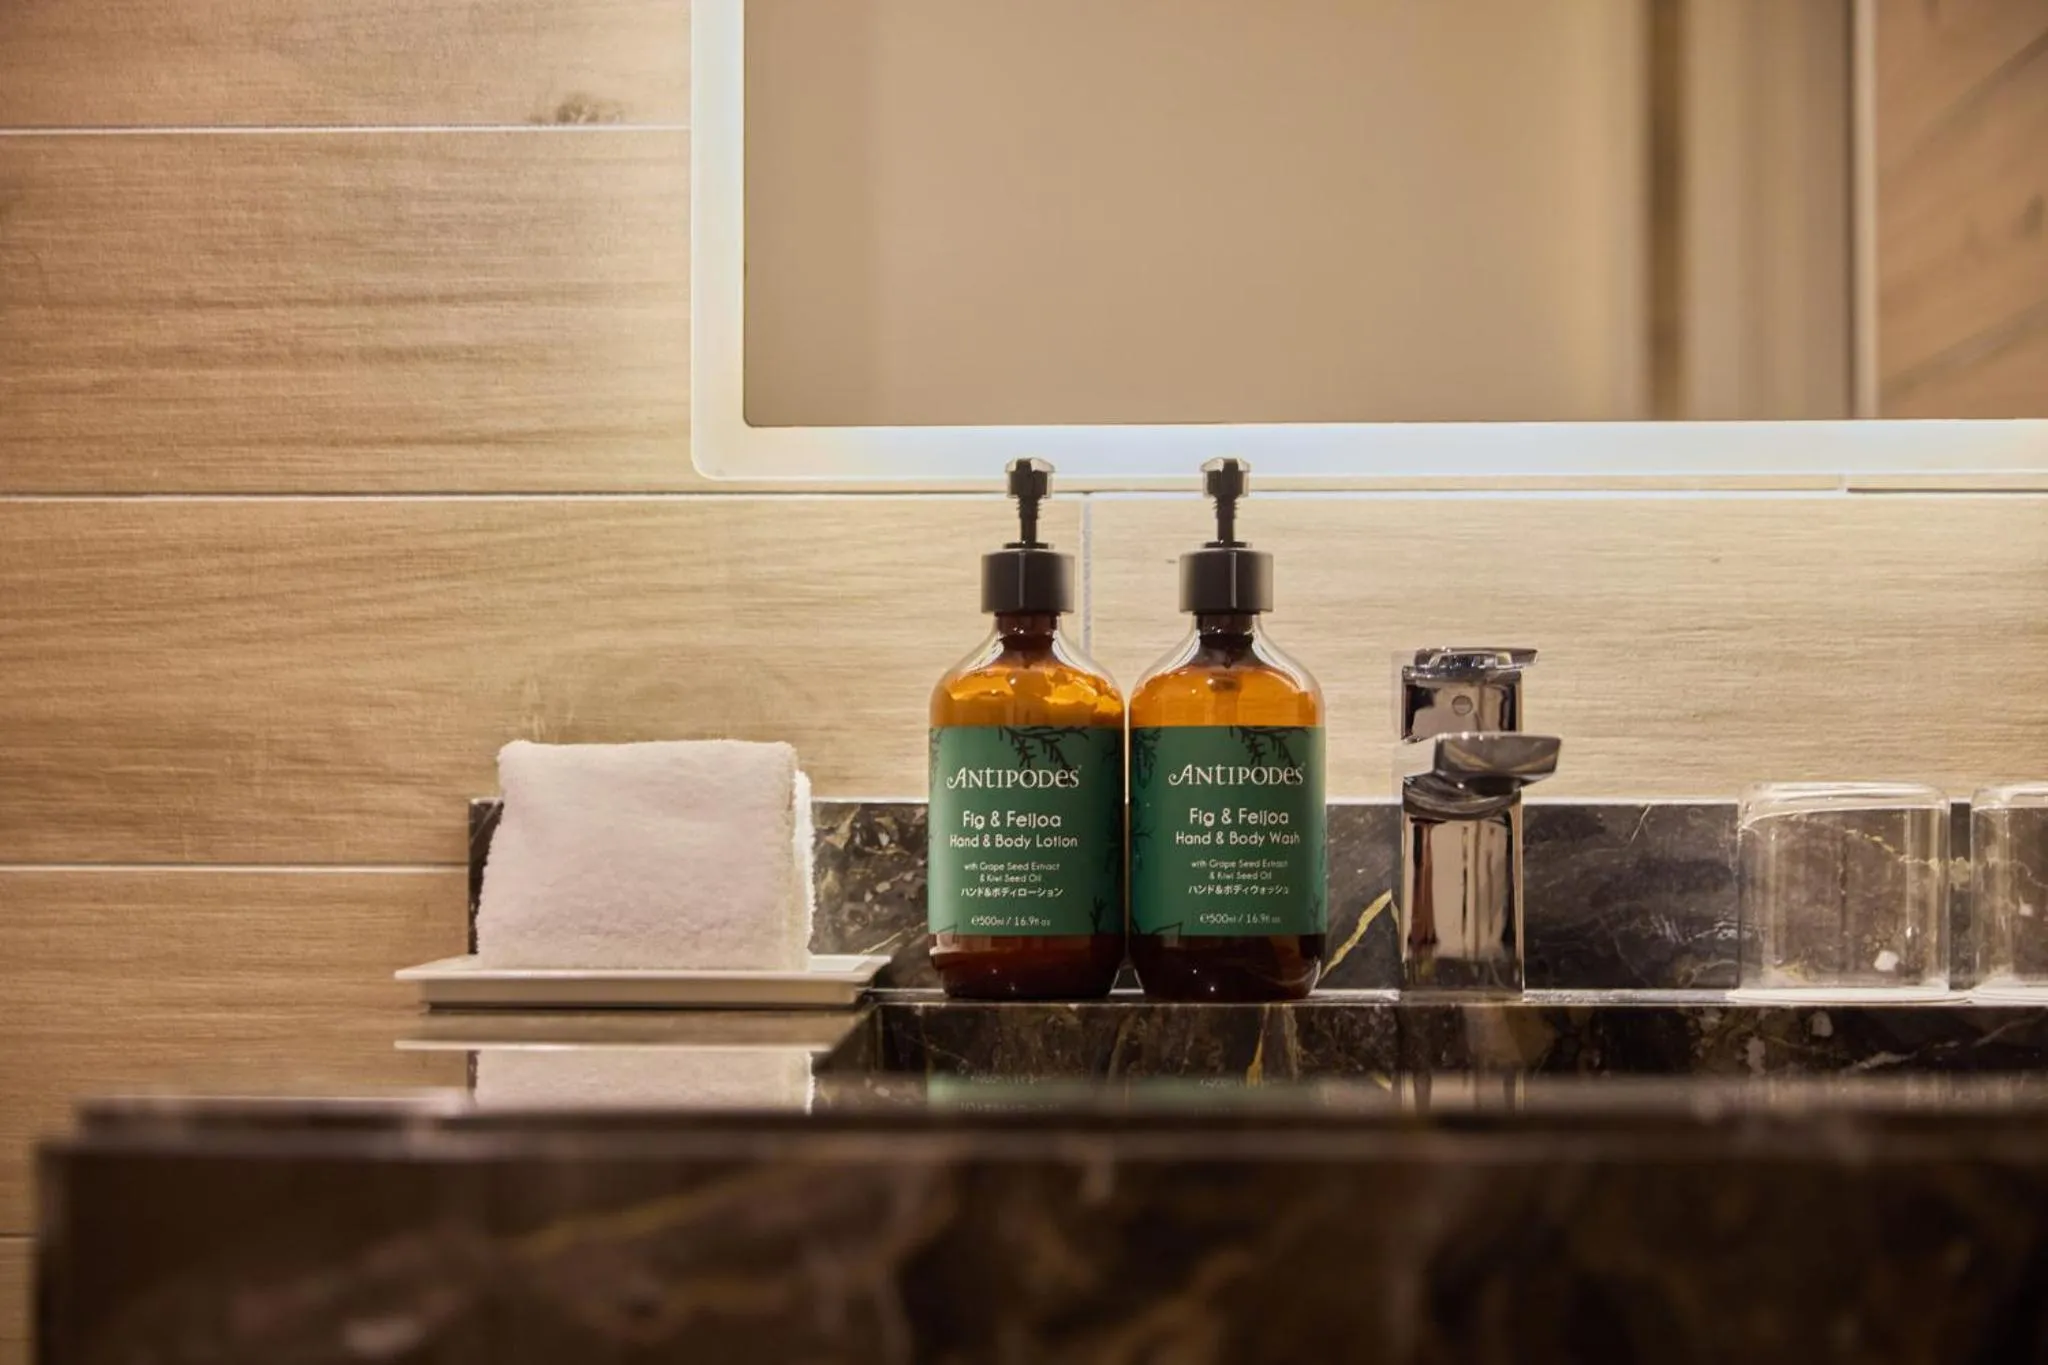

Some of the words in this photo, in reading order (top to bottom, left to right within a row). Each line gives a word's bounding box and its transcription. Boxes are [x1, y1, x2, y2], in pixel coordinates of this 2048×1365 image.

[963, 810, 985, 830] Fig
[990, 810, 1000, 827] &
[1007, 810, 1062, 829] Feijoa
[1189, 807, 1215, 827] Fig
[1221, 807, 1232, 825] &
[1238, 807, 1289, 826] Feijoa
[950, 834, 979, 848] Hand
[983, 834, 991, 847] &
[995, 834, 1032, 849] Body
[1036, 835, 1078, 847] Lotion
[1175, 832, 1211, 845] Hand
[1215, 831, 1224, 845] &
[1229, 831, 1266, 847] Body
[1268, 832, 1300, 845] Wash
[963, 862, 978, 871] with
[979, 862, 1004, 873] Grape
[1007, 862, 1029, 871] Seed
[1031, 862, 1060, 871] Extract
[1239, 859, 1261, 868] Seed
[1004, 874, 1026, 883] Seed
[1028, 873, 1042, 883] Oil
[1236, 871, 1258, 881] Seed
[1260, 871, 1272, 880] Oil
